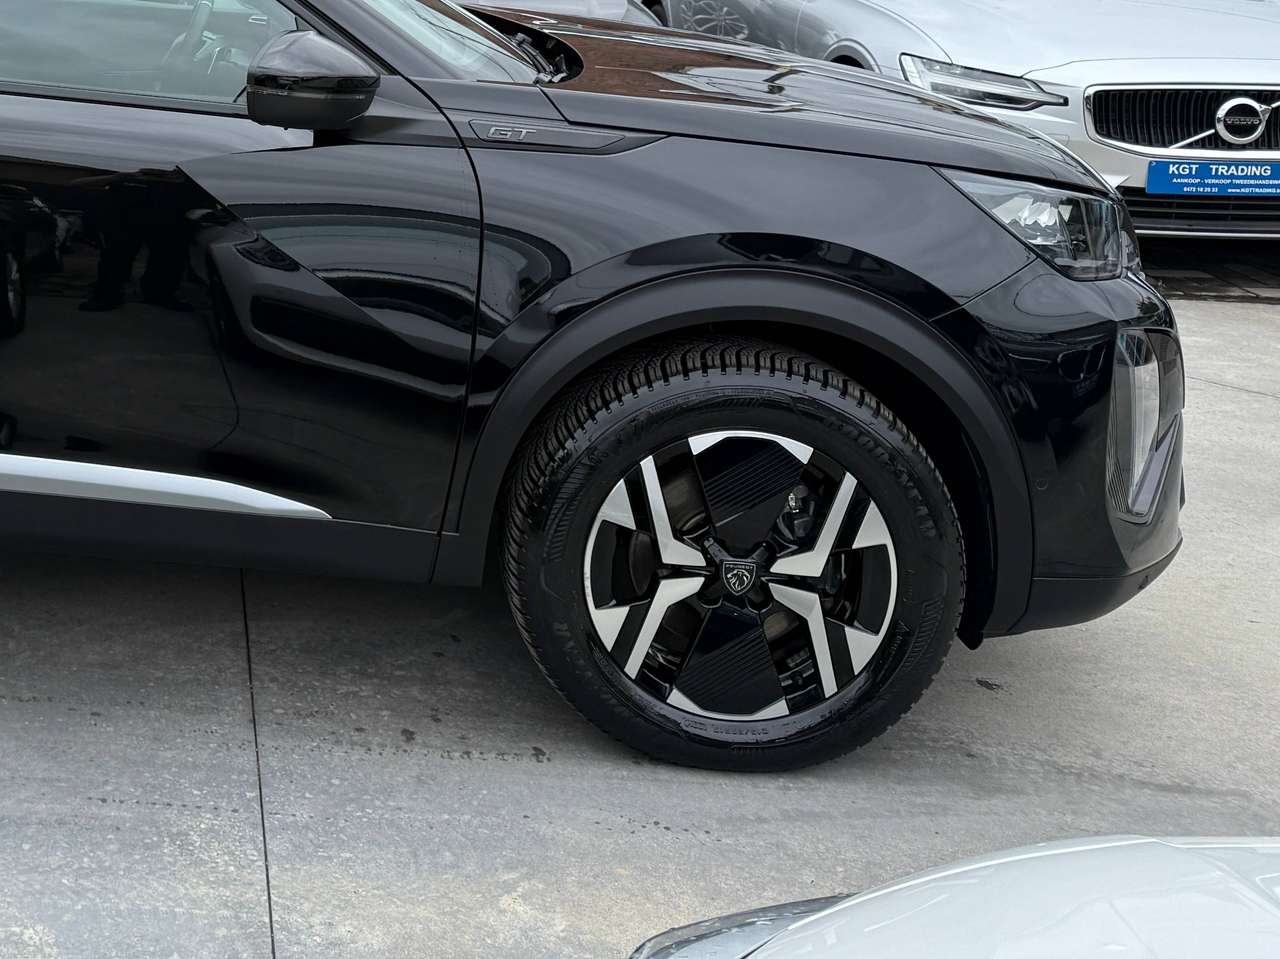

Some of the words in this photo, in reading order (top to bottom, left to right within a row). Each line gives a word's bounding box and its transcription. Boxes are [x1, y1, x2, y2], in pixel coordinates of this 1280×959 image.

[487, 127, 537, 140] GT
[1168, 164, 1199, 175] KGT
[1209, 165, 1272, 176] TRADING
